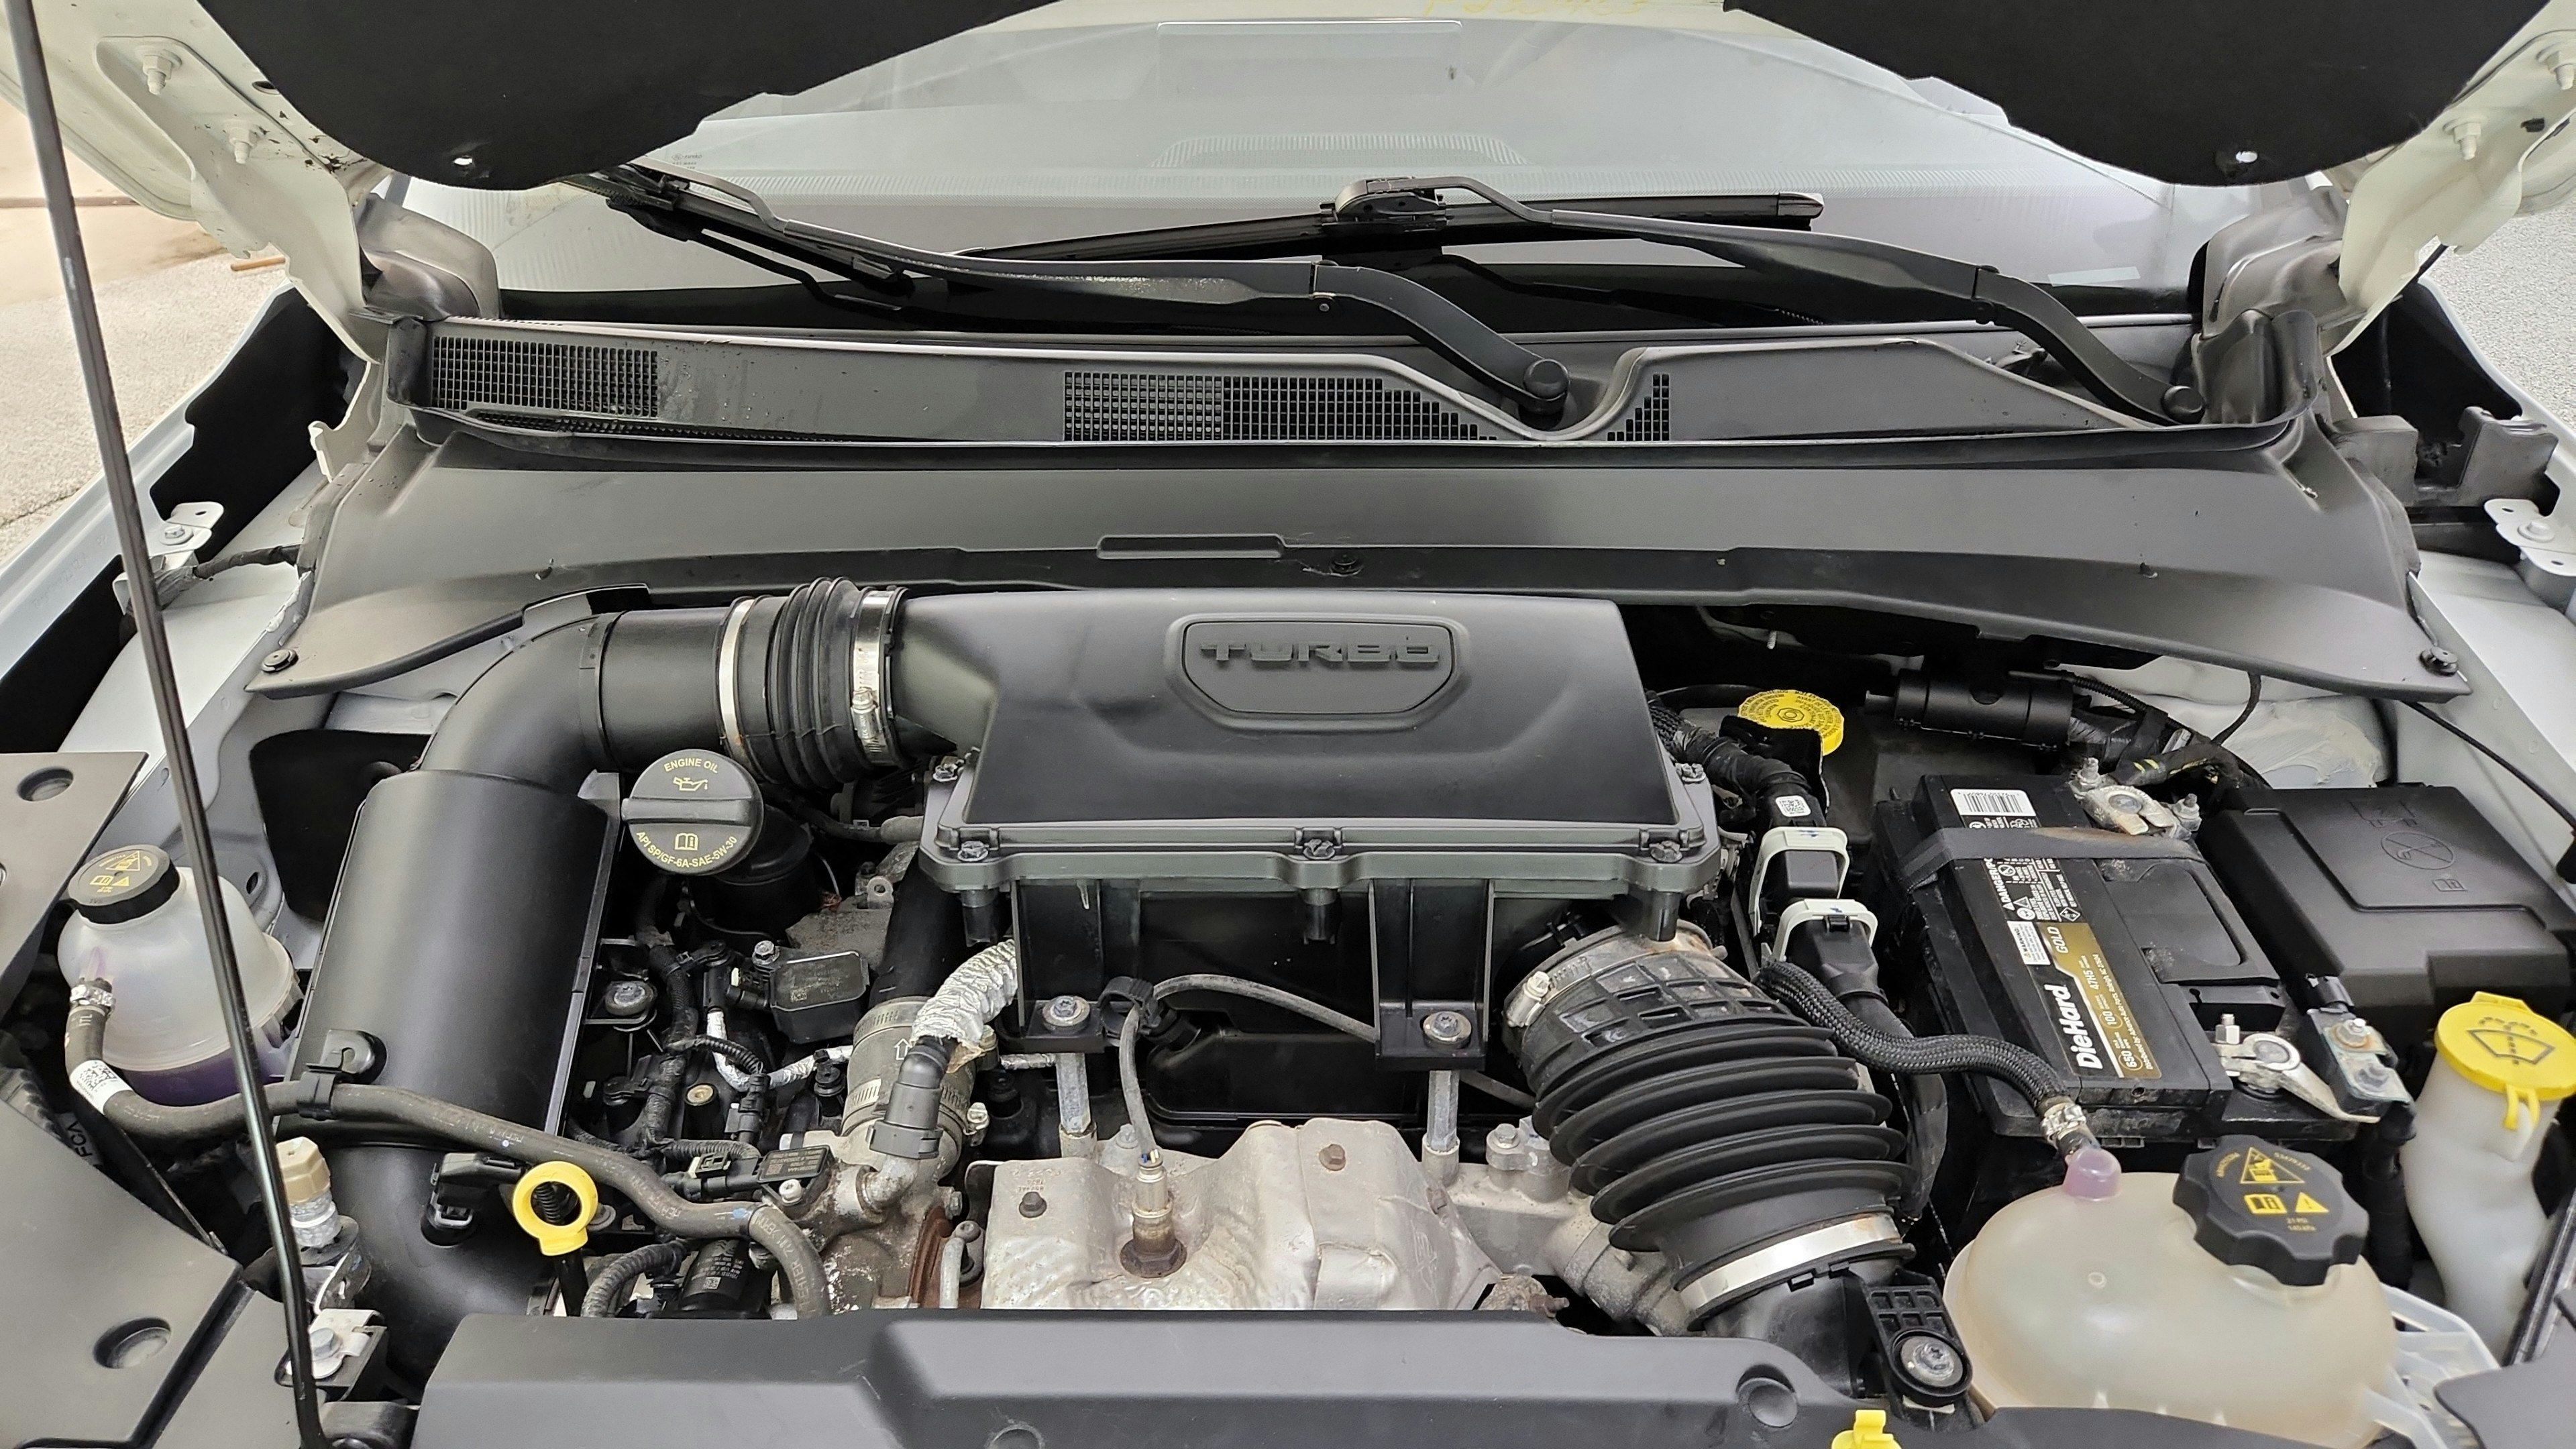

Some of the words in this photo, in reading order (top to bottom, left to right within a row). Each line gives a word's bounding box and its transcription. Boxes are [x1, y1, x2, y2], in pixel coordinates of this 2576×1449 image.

[1201, 641, 1440, 664] TURBO
[663, 758, 702, 772] ENGINE
[703, 759, 718, 773] OIL
[637, 830, 651, 848] API
[647, 836, 737, 868] SP/GF-6A-SAE-5W-30
[2047, 926, 2068, 953] GOLD
[2083, 970, 2100, 989] 47H5
[2102, 1011, 2117, 1024] 100
[2117, 1006, 2127, 1016] Auto
[2044, 984, 2103, 1069] DieHard
[2123, 1017, 2136, 1035] Advance
[2121, 1051, 2137, 1067] 650
[2136, 1044, 2152, 1069] Distributed
